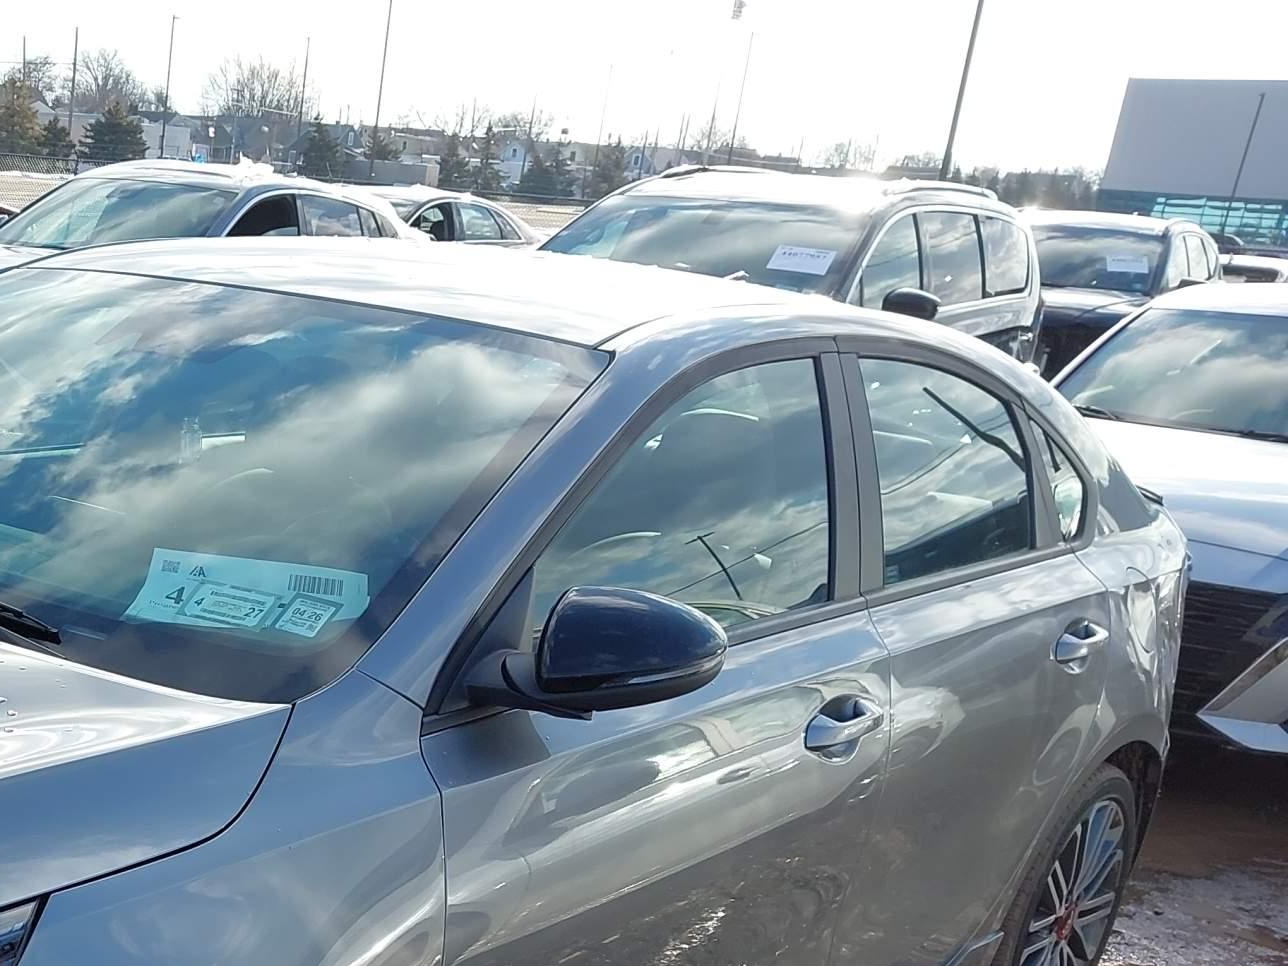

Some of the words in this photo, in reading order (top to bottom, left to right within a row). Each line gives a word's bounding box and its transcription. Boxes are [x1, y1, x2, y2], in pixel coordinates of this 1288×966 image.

[165, 586, 185, 605] 4
[193, 596, 206, 607] 4
[243, 607, 264, 619] 27
